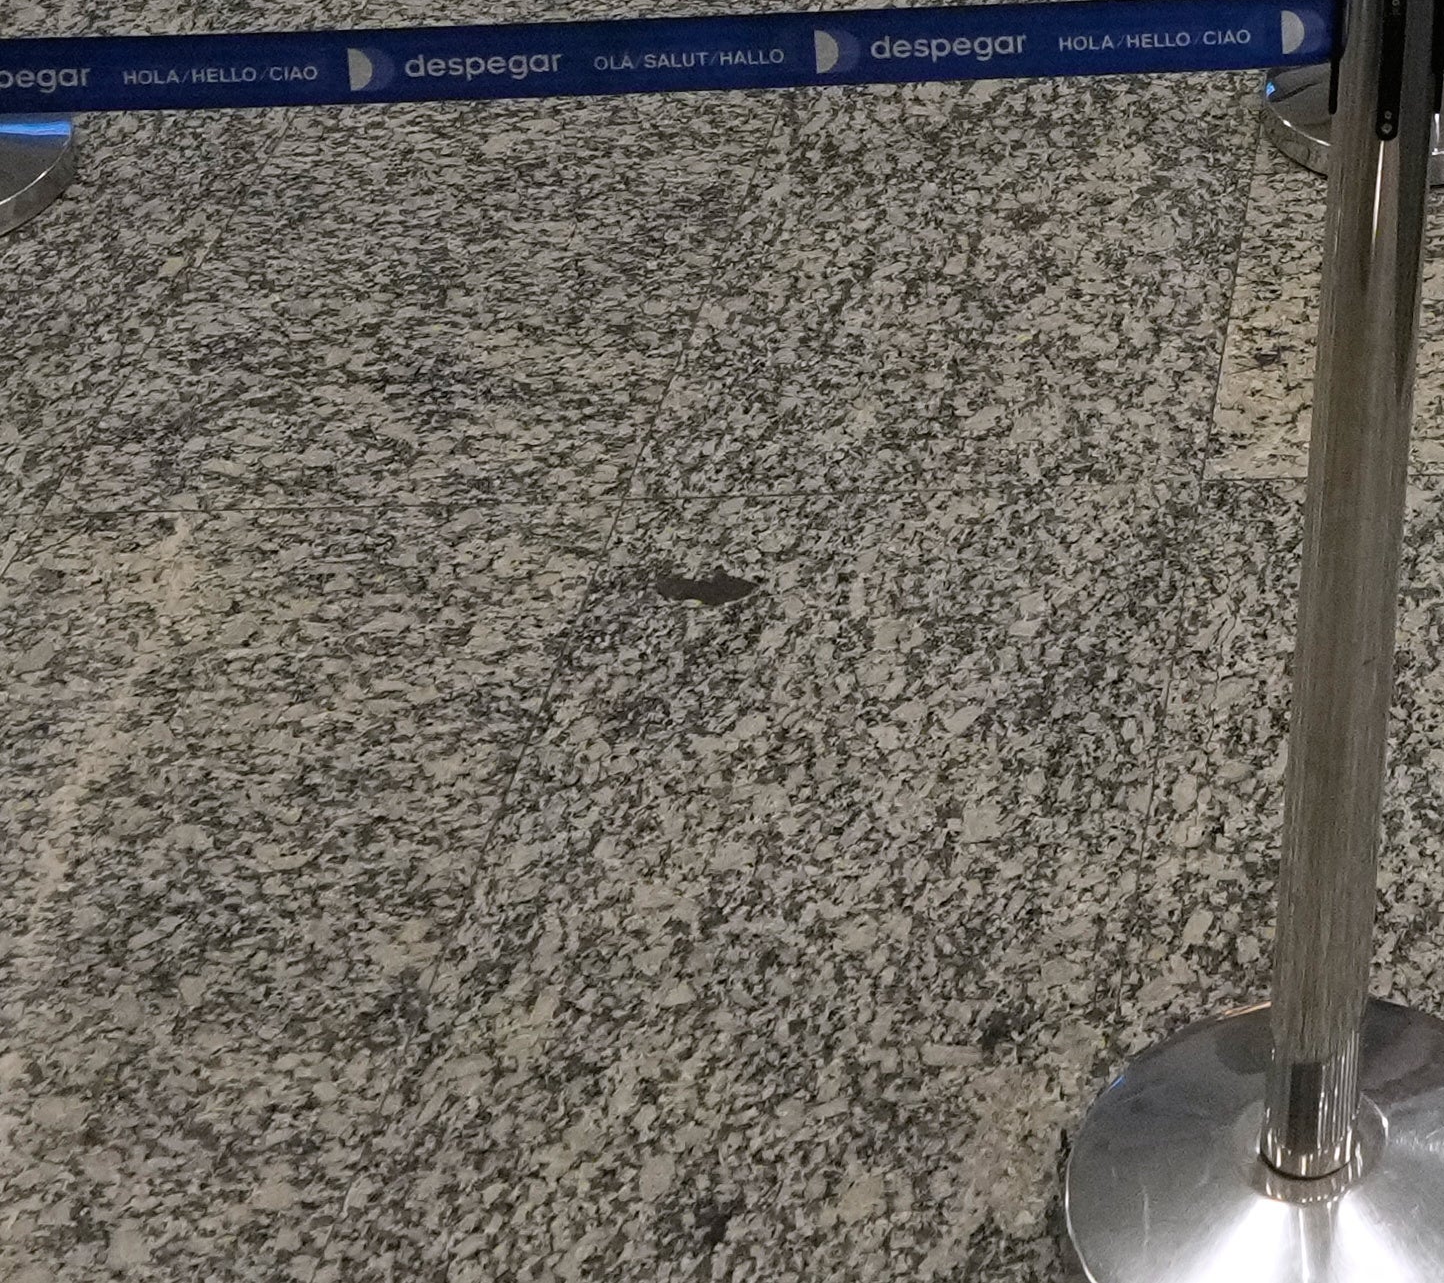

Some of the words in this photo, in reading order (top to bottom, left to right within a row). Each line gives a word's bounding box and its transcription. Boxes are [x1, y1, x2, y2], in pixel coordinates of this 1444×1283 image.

[0, 68, 90, 94] pegar
[405, 54, 561, 81] despegar
[871, 34, 1026, 62] despegar
